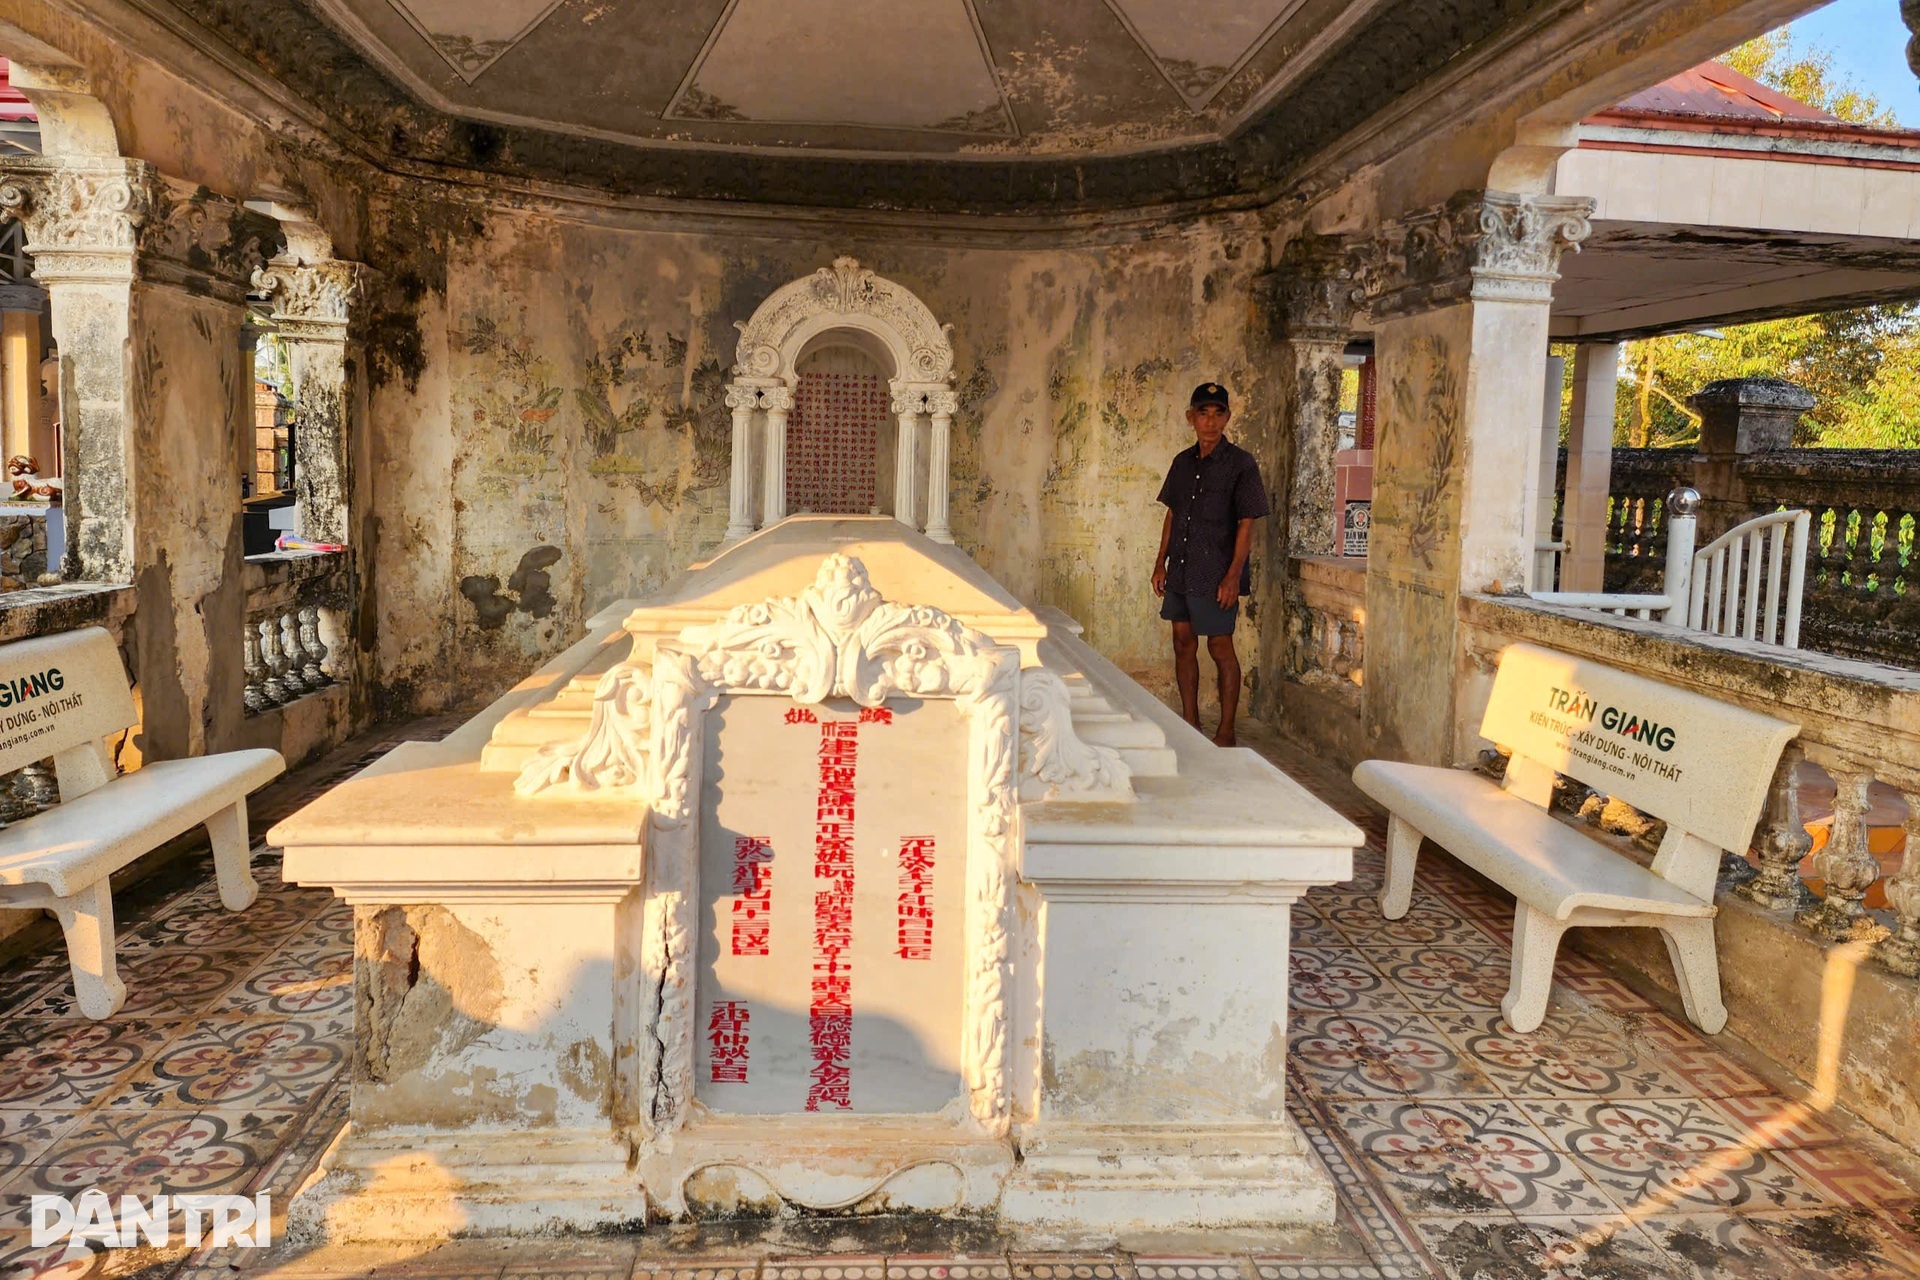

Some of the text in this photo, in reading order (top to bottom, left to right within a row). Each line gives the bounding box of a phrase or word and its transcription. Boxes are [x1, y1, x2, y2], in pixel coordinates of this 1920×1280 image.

[0, 668, 64, 707] GIANG
[6, 709, 37, 731] DỰNG
[41, 700, 60, 719] NỘI
[60, 691, 83, 711] THẤT
[1601, 706, 1676, 752] GIANG
[1529, 710, 1683, 783] KIẾN TRÚC XÂY DỰNG NỘI THẤT
[1555, 741, 1637, 781] www.trangiang.com.vn
